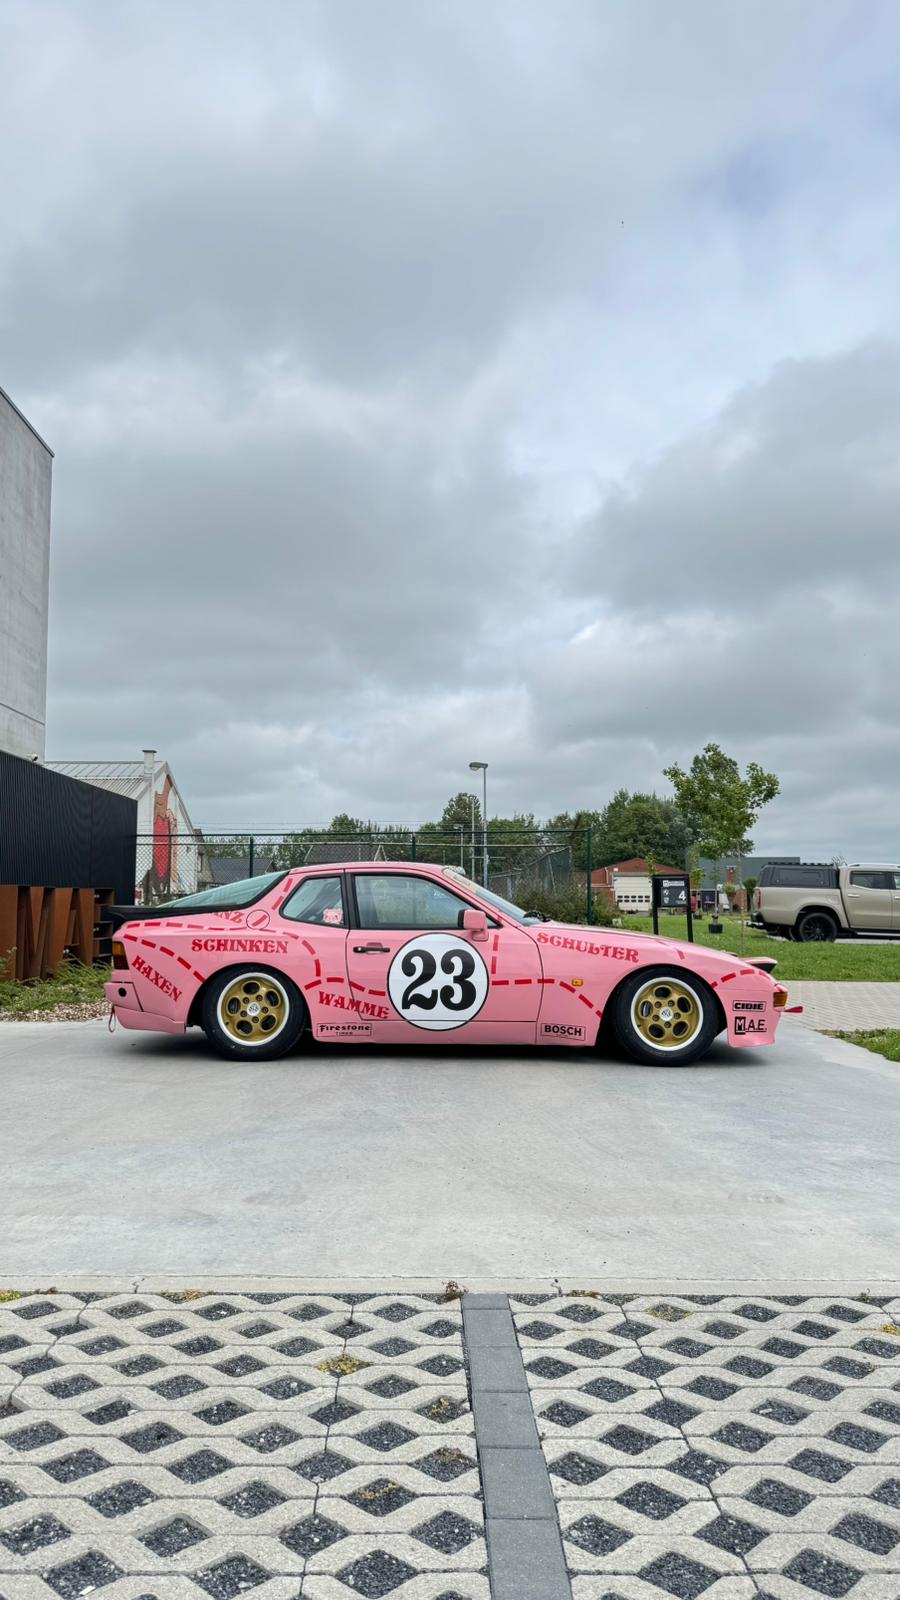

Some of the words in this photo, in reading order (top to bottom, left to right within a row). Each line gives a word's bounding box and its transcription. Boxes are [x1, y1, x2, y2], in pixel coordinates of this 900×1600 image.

[678, 890, 686, 901] 4
[191, 938, 289, 954] SCHINKEN
[536, 932, 639, 963] SCHULTER
[131, 955, 182, 1002] HAXEN
[402, 949, 477, 1011] 23
[319, 991, 390, 1019] WAMME
[319, 1024, 371, 1033] Firestone
[544, 1025, 582, 1036] BOSCH
